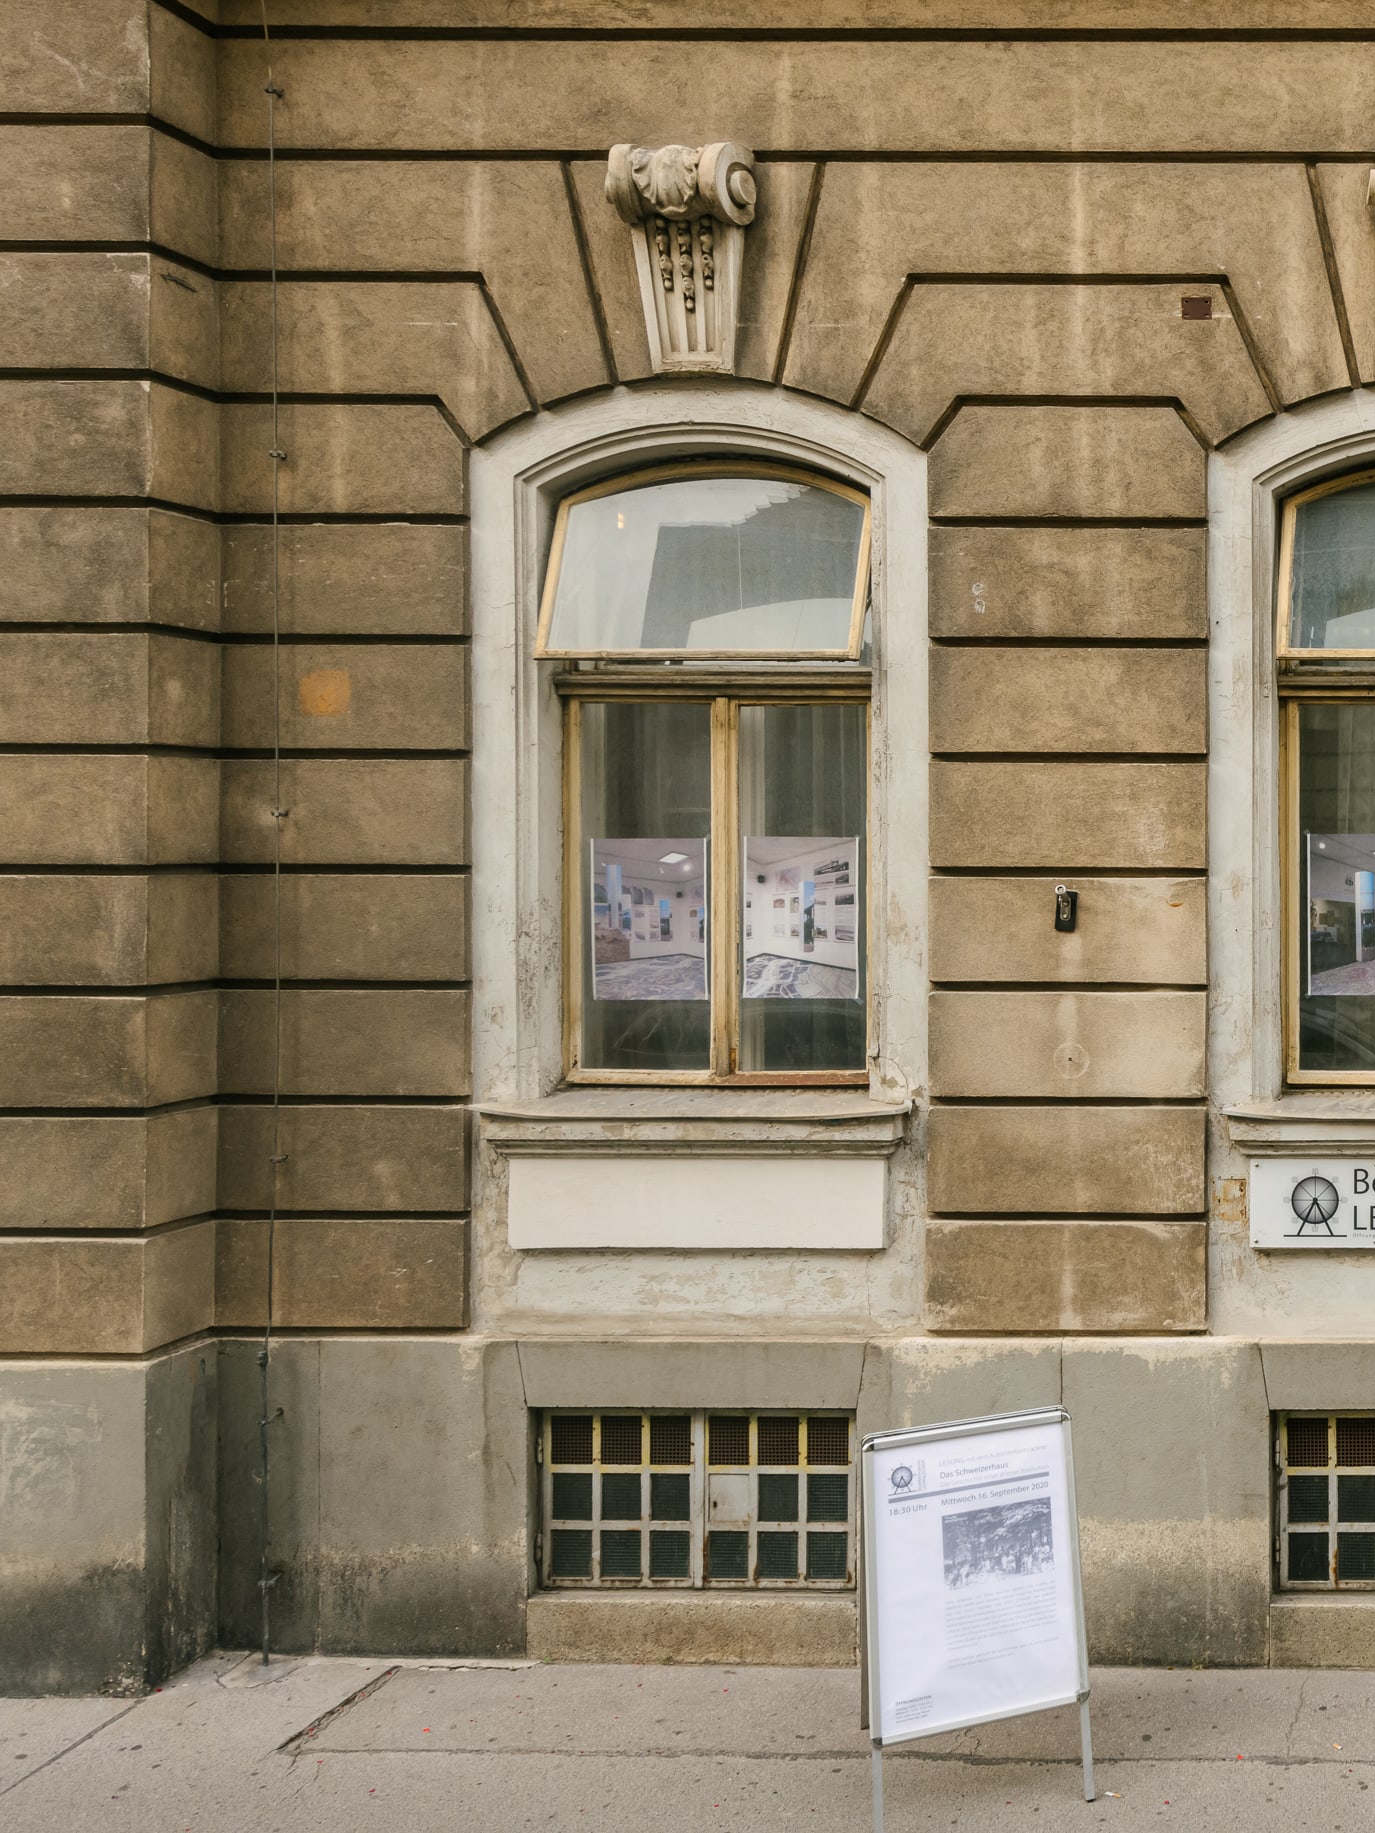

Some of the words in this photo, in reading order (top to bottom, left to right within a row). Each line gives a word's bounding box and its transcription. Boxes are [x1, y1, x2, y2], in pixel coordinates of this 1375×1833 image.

[940, 1470, 954, 1479] Das
[955, 1461, 1009, 1477] Schweizerhaus
[889, 1506, 911, 1516] 18:30
[912, 1504, 928, 1512] Uhr
[941, 1494, 976, 1507] Mittwoch
[978, 1492, 989, 1501] 16.
[990, 1484, 1030, 1500] September
[1031, 1481, 1049, 1491] 2020
